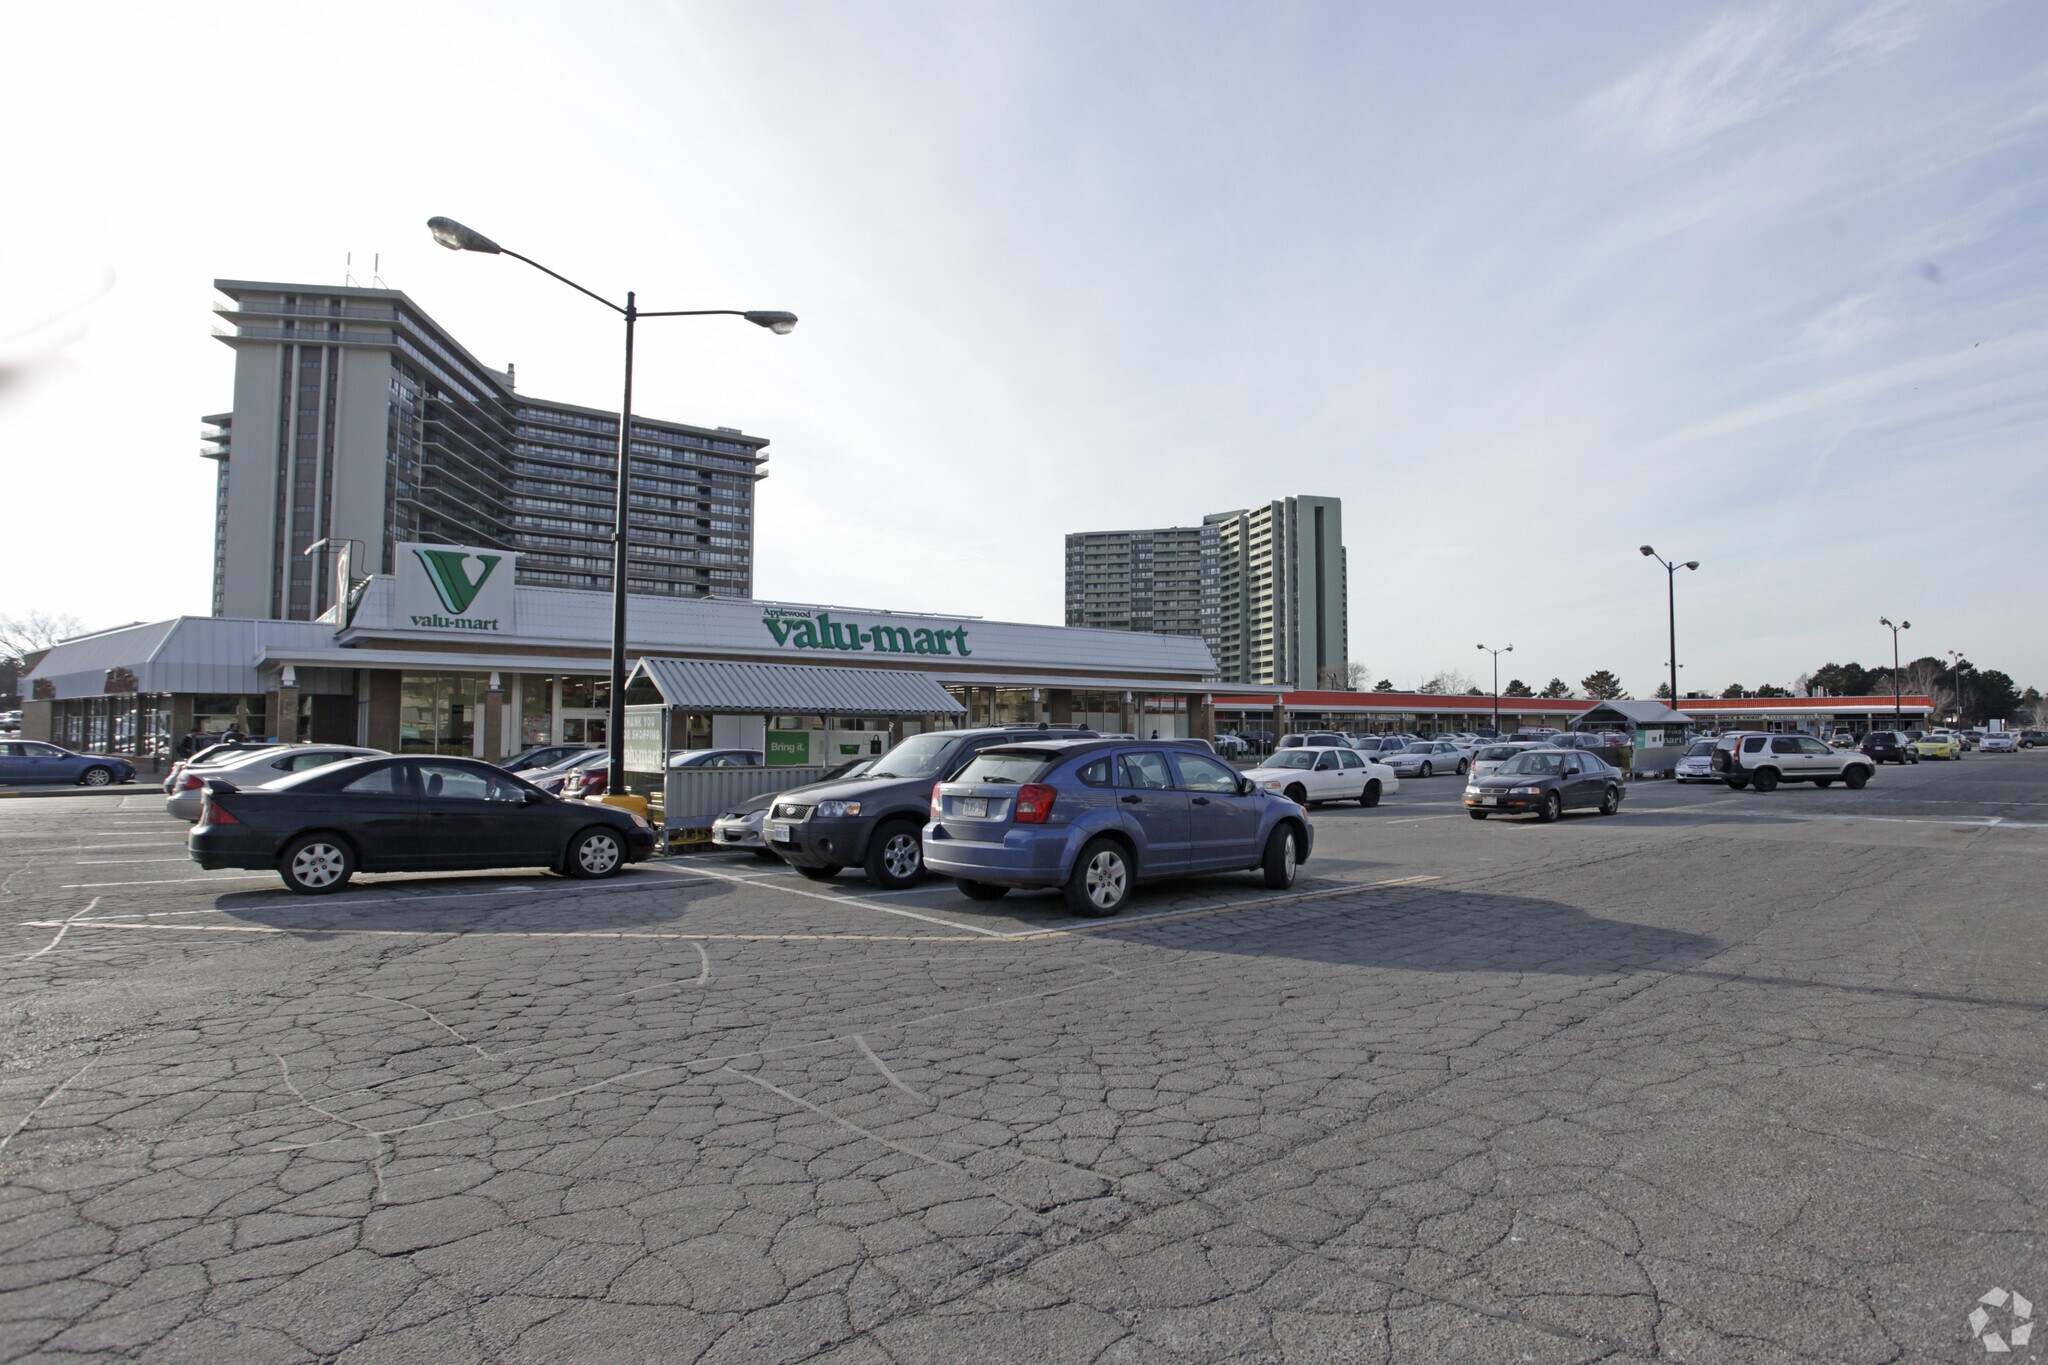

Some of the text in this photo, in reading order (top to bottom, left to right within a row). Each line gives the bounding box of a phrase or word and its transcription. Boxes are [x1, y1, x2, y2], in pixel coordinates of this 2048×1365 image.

[763, 607, 811, 619] Applewood
[410, 613, 499, 631] valu-mart
[762, 612, 973, 657] valu-mart
[624, 716, 655, 727] HANK YOU
[632, 729, 661, 741] SHOPPING
[771, 741, 805, 753] Bring it.
[624, 745, 661, 766] alu-mart
